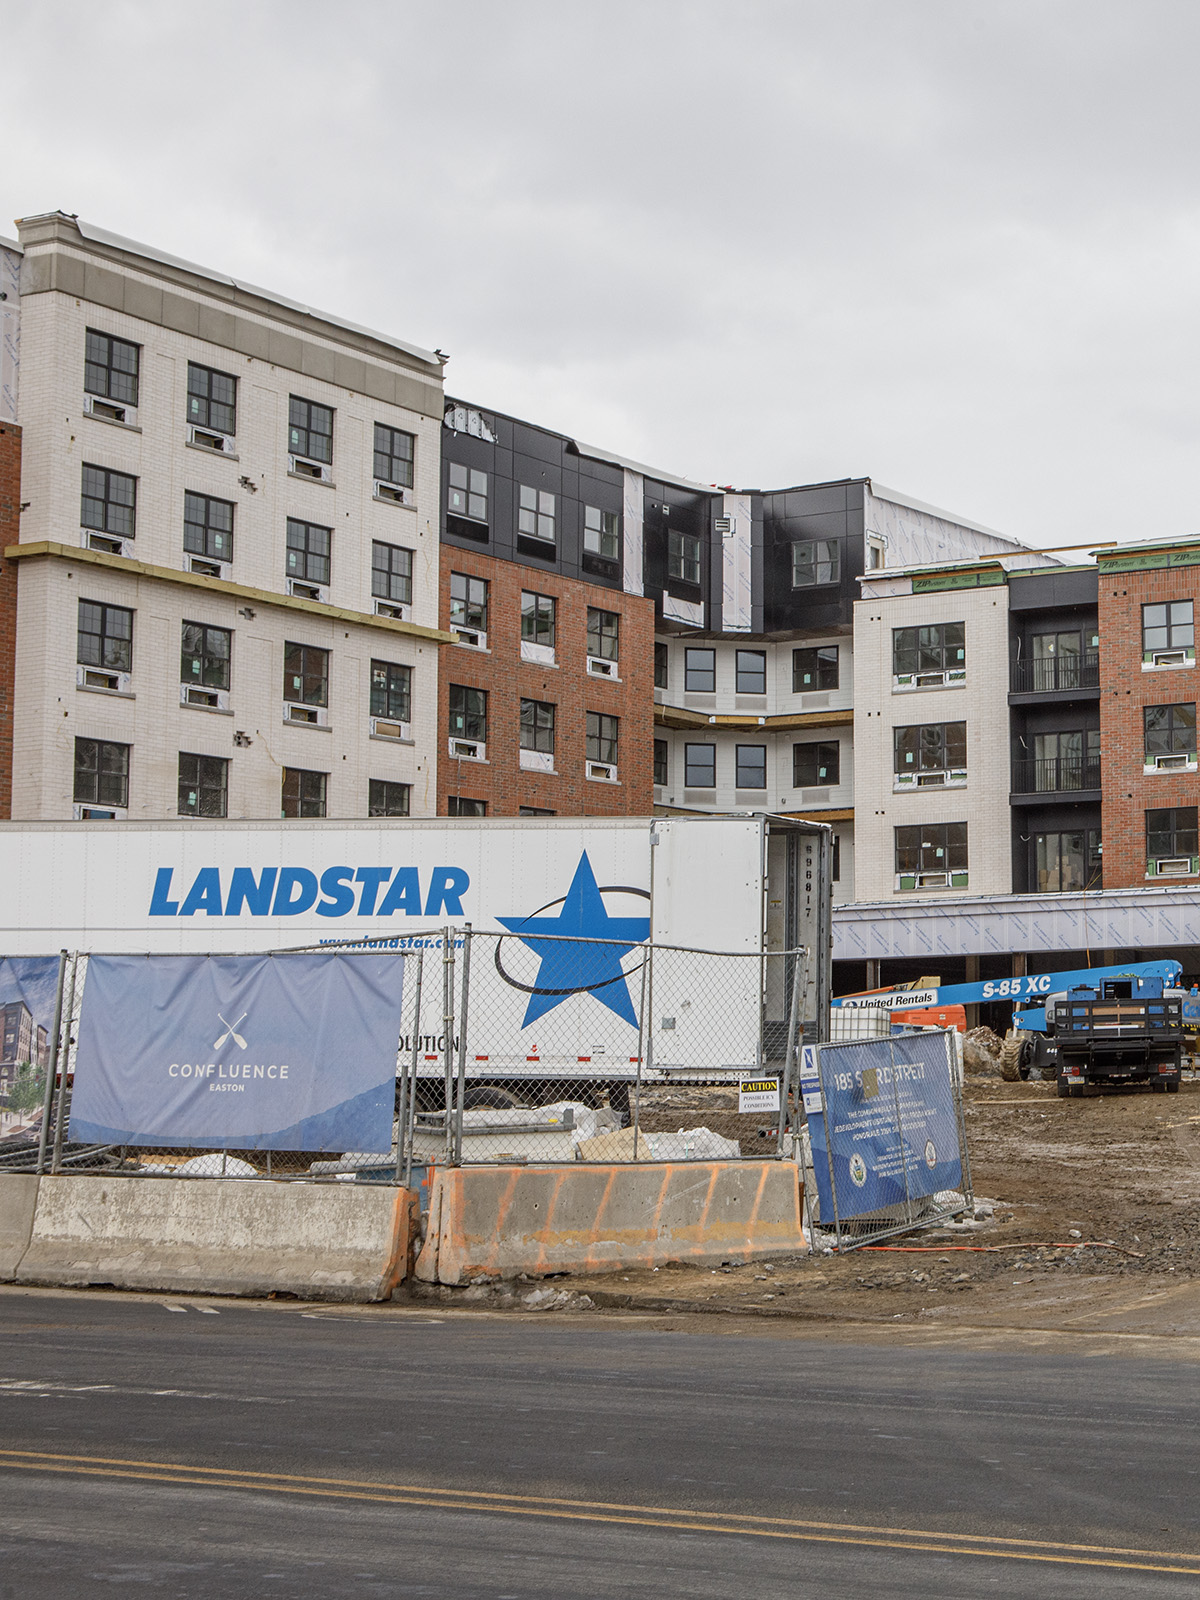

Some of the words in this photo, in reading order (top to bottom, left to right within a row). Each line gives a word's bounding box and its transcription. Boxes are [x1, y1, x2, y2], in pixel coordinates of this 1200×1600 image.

[148, 865, 470, 918] LANDSTAR
[982, 979, 1021, 998] S-85
[1025, 975, 1051, 993] XC
[860, 997, 893, 1008] United
[895, 993, 932, 1005] Rentals
[168, 1063, 289, 1079] CONFLUENCE
[209, 1083, 245, 1092] EASTON
[741, 1081, 777, 1092] CAUTION
[834, 1072, 853, 1091] 185
